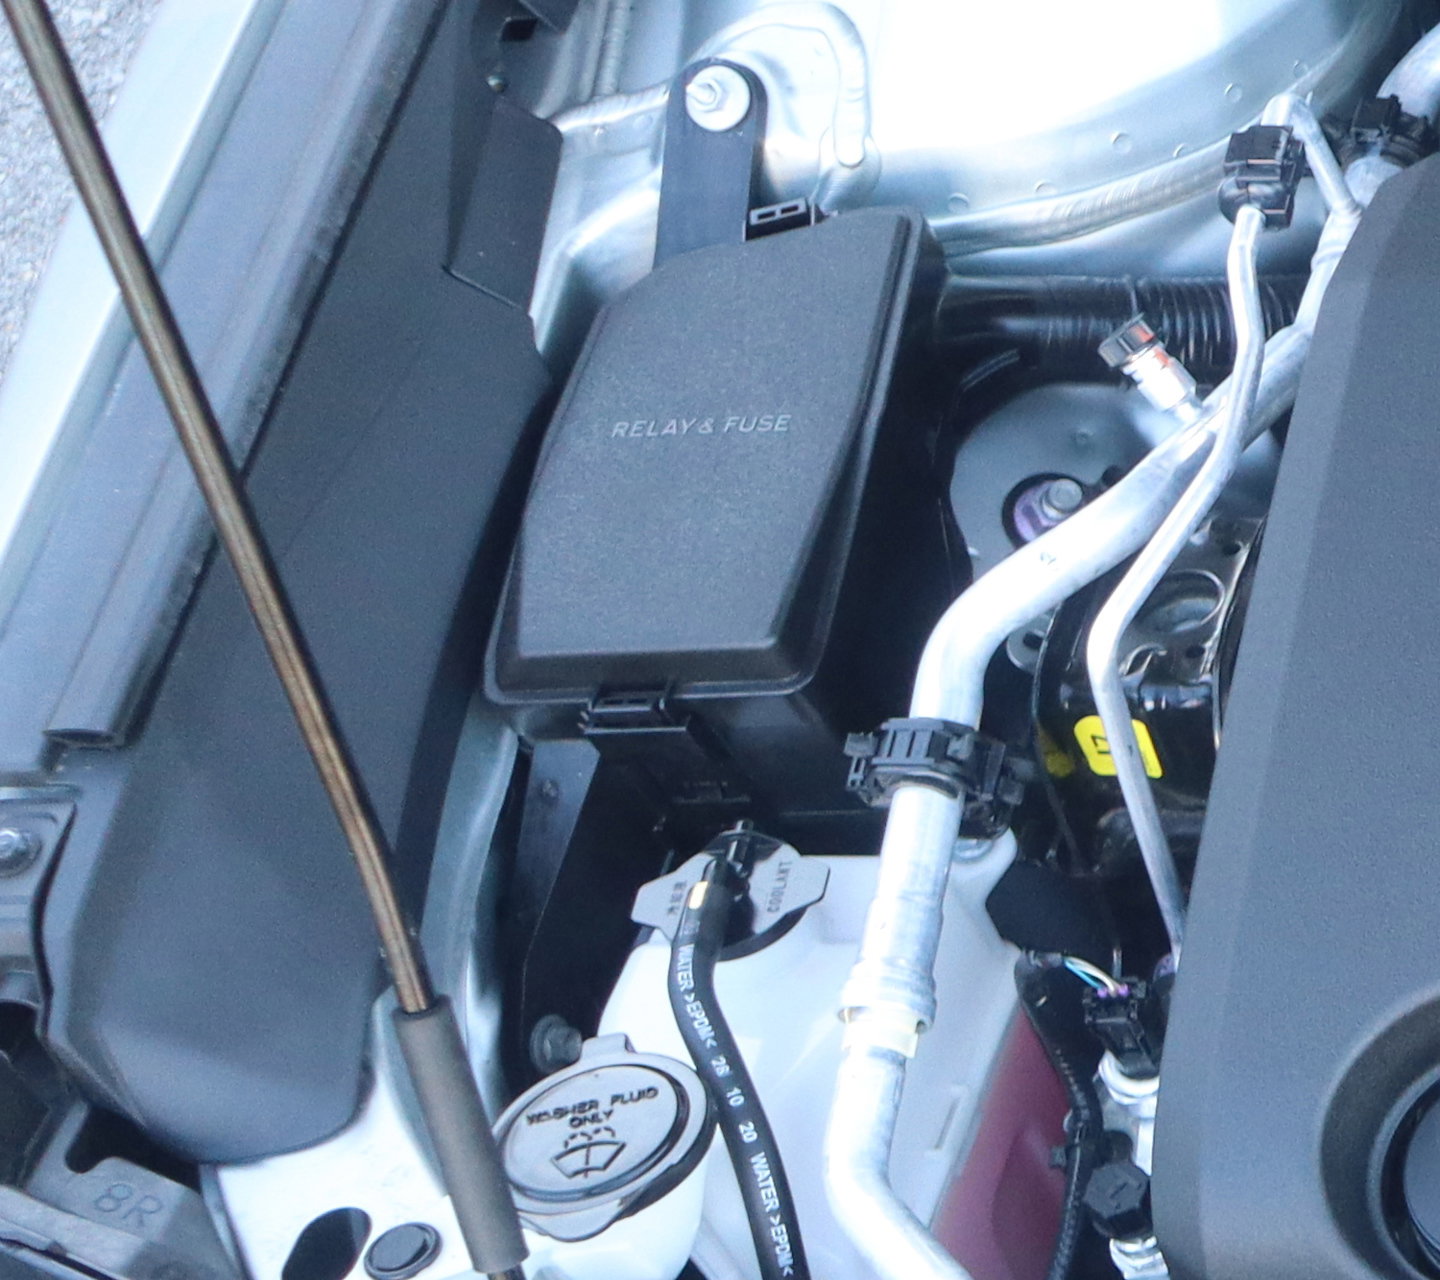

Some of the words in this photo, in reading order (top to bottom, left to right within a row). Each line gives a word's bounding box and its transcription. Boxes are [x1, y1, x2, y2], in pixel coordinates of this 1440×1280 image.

[612, 418, 696, 438] RELAY
[724, 414, 792, 433] FUSE
[767, 861, 793, 914] COOLANT
[527, 1099, 599, 1126] WASHER
[611, 1086, 659, 1106] FLUID
[569, 1109, 614, 1129] ONLY
[677, 943, 697, 993] WATER
[726, 1086, 744, 1107] 10
[738, 1121, 758, 1144] 20
[748, 1151, 780, 1213] WATER
[769, 1214, 794, 1277] >EPDM<
[94, 1183, 164, 1228] 8R
